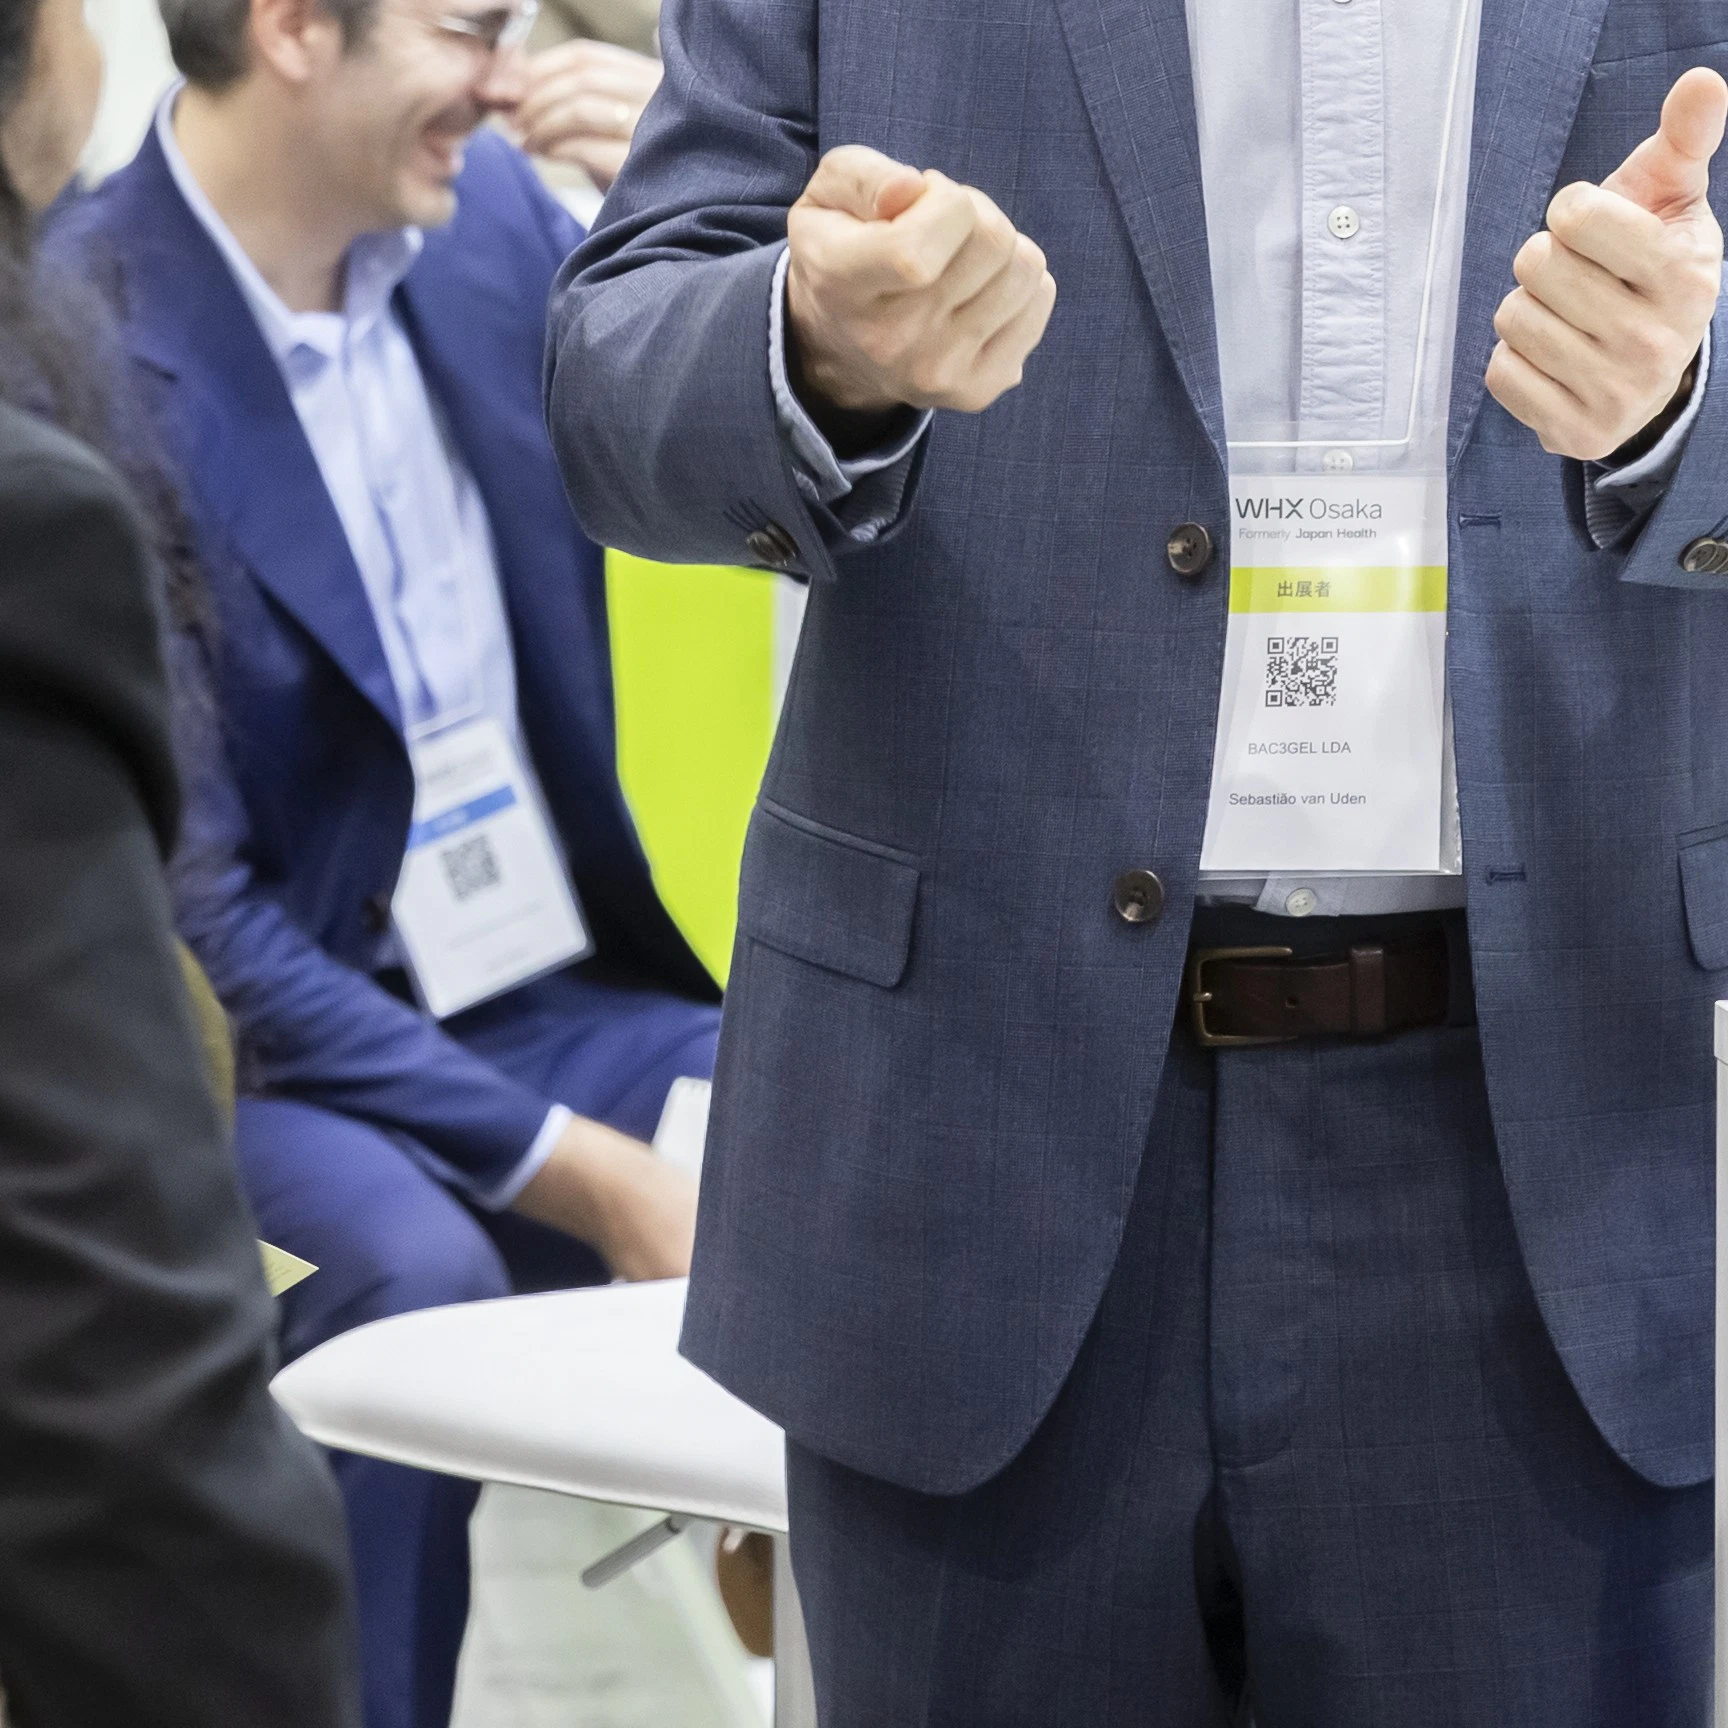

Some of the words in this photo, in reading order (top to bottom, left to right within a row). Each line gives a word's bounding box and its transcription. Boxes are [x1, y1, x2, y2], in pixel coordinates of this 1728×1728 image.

[1235, 498, 1304, 519] WHX
[1309, 498, 1382, 520] Osaka
[1239, 528, 1291, 541] Formerly
[1295, 528, 1333, 541] Japan
[1337, 528, 1377, 539] Health
[1277, 580, 1332, 598] 出展者
[1248, 742, 1317, 755] BAC3GEL
[1322, 741, 1352, 754] LDA
[1301, 795, 1325, 804] van
[1330, 792, 1367, 805] Uden
